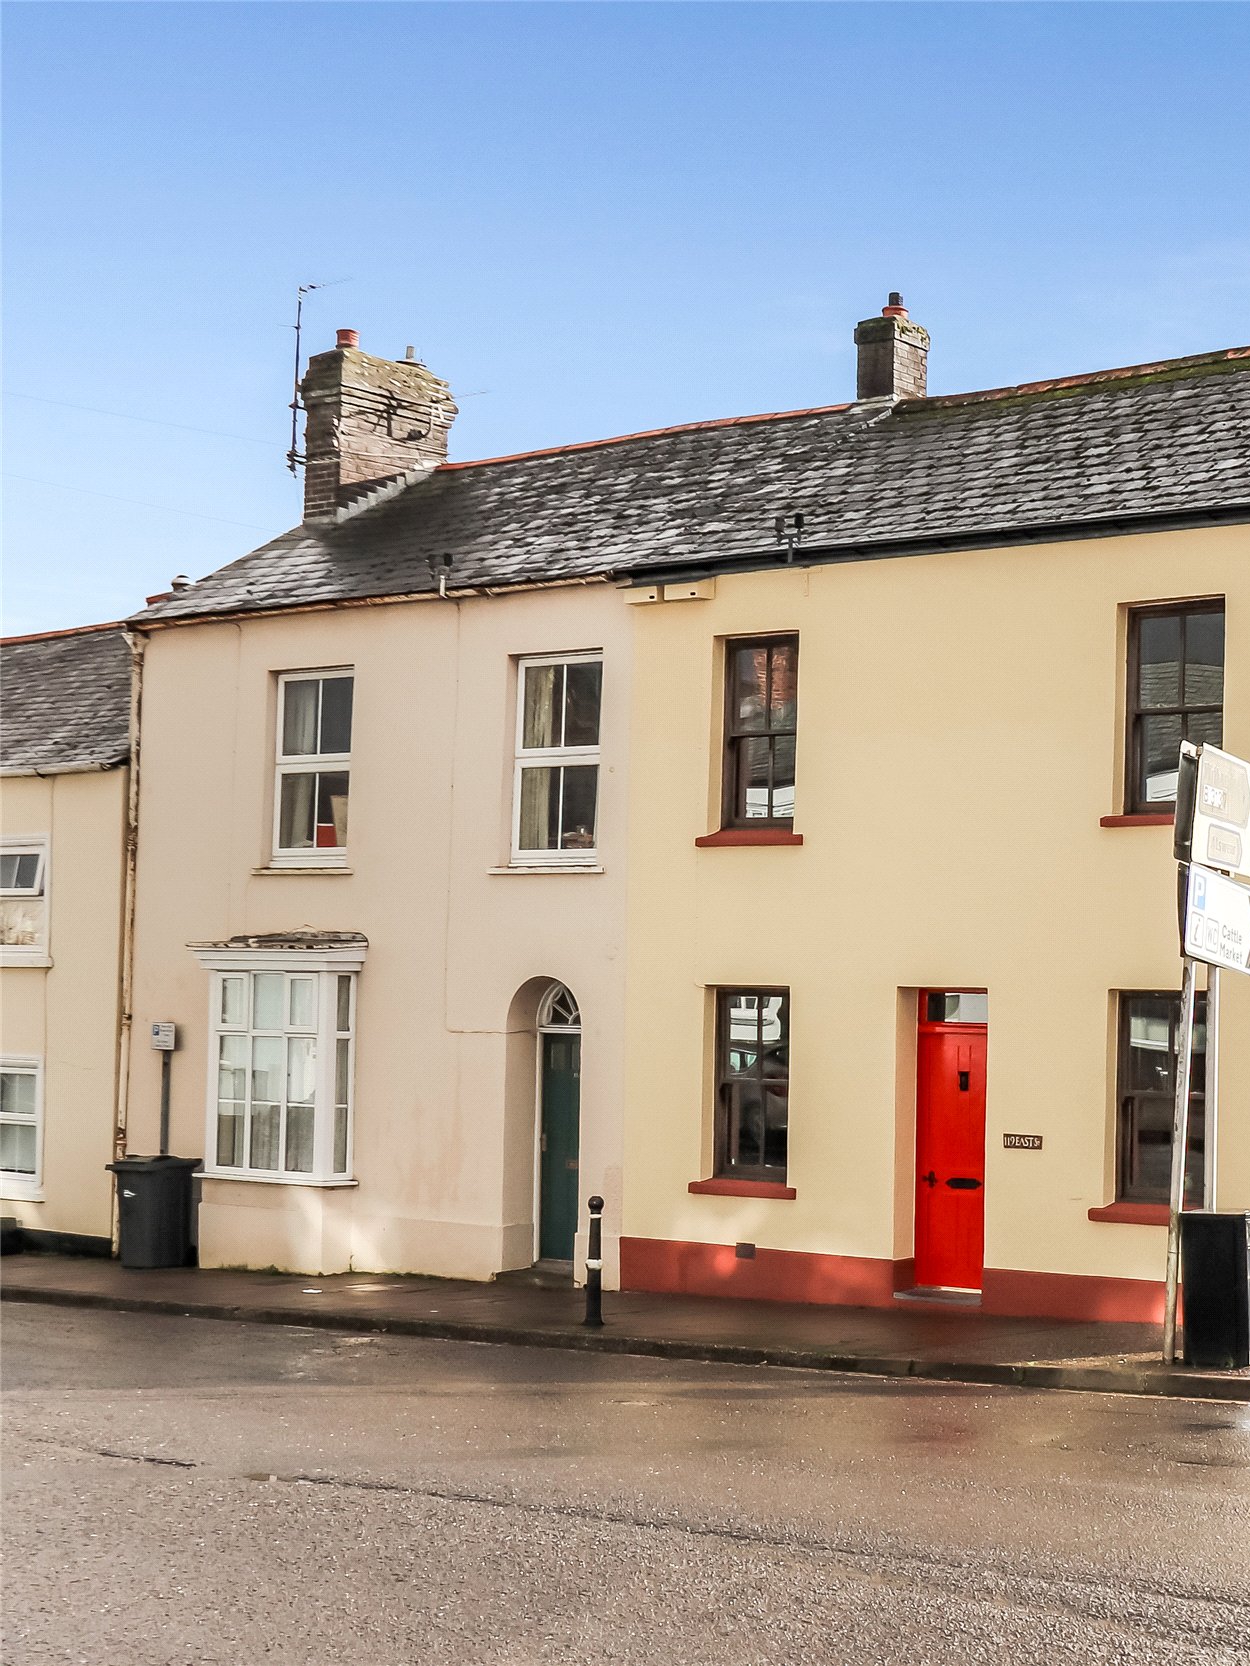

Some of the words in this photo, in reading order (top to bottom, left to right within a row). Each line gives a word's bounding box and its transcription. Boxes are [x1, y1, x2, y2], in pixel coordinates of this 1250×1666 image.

[1207, 925, 1218, 946] WC
[1221, 924, 1243, 945] Cattle
[1219, 942, 1243, 965] Market
[1004, 1136, 1015, 1146] 119
[1015, 1136, 1034, 1147] EAST
